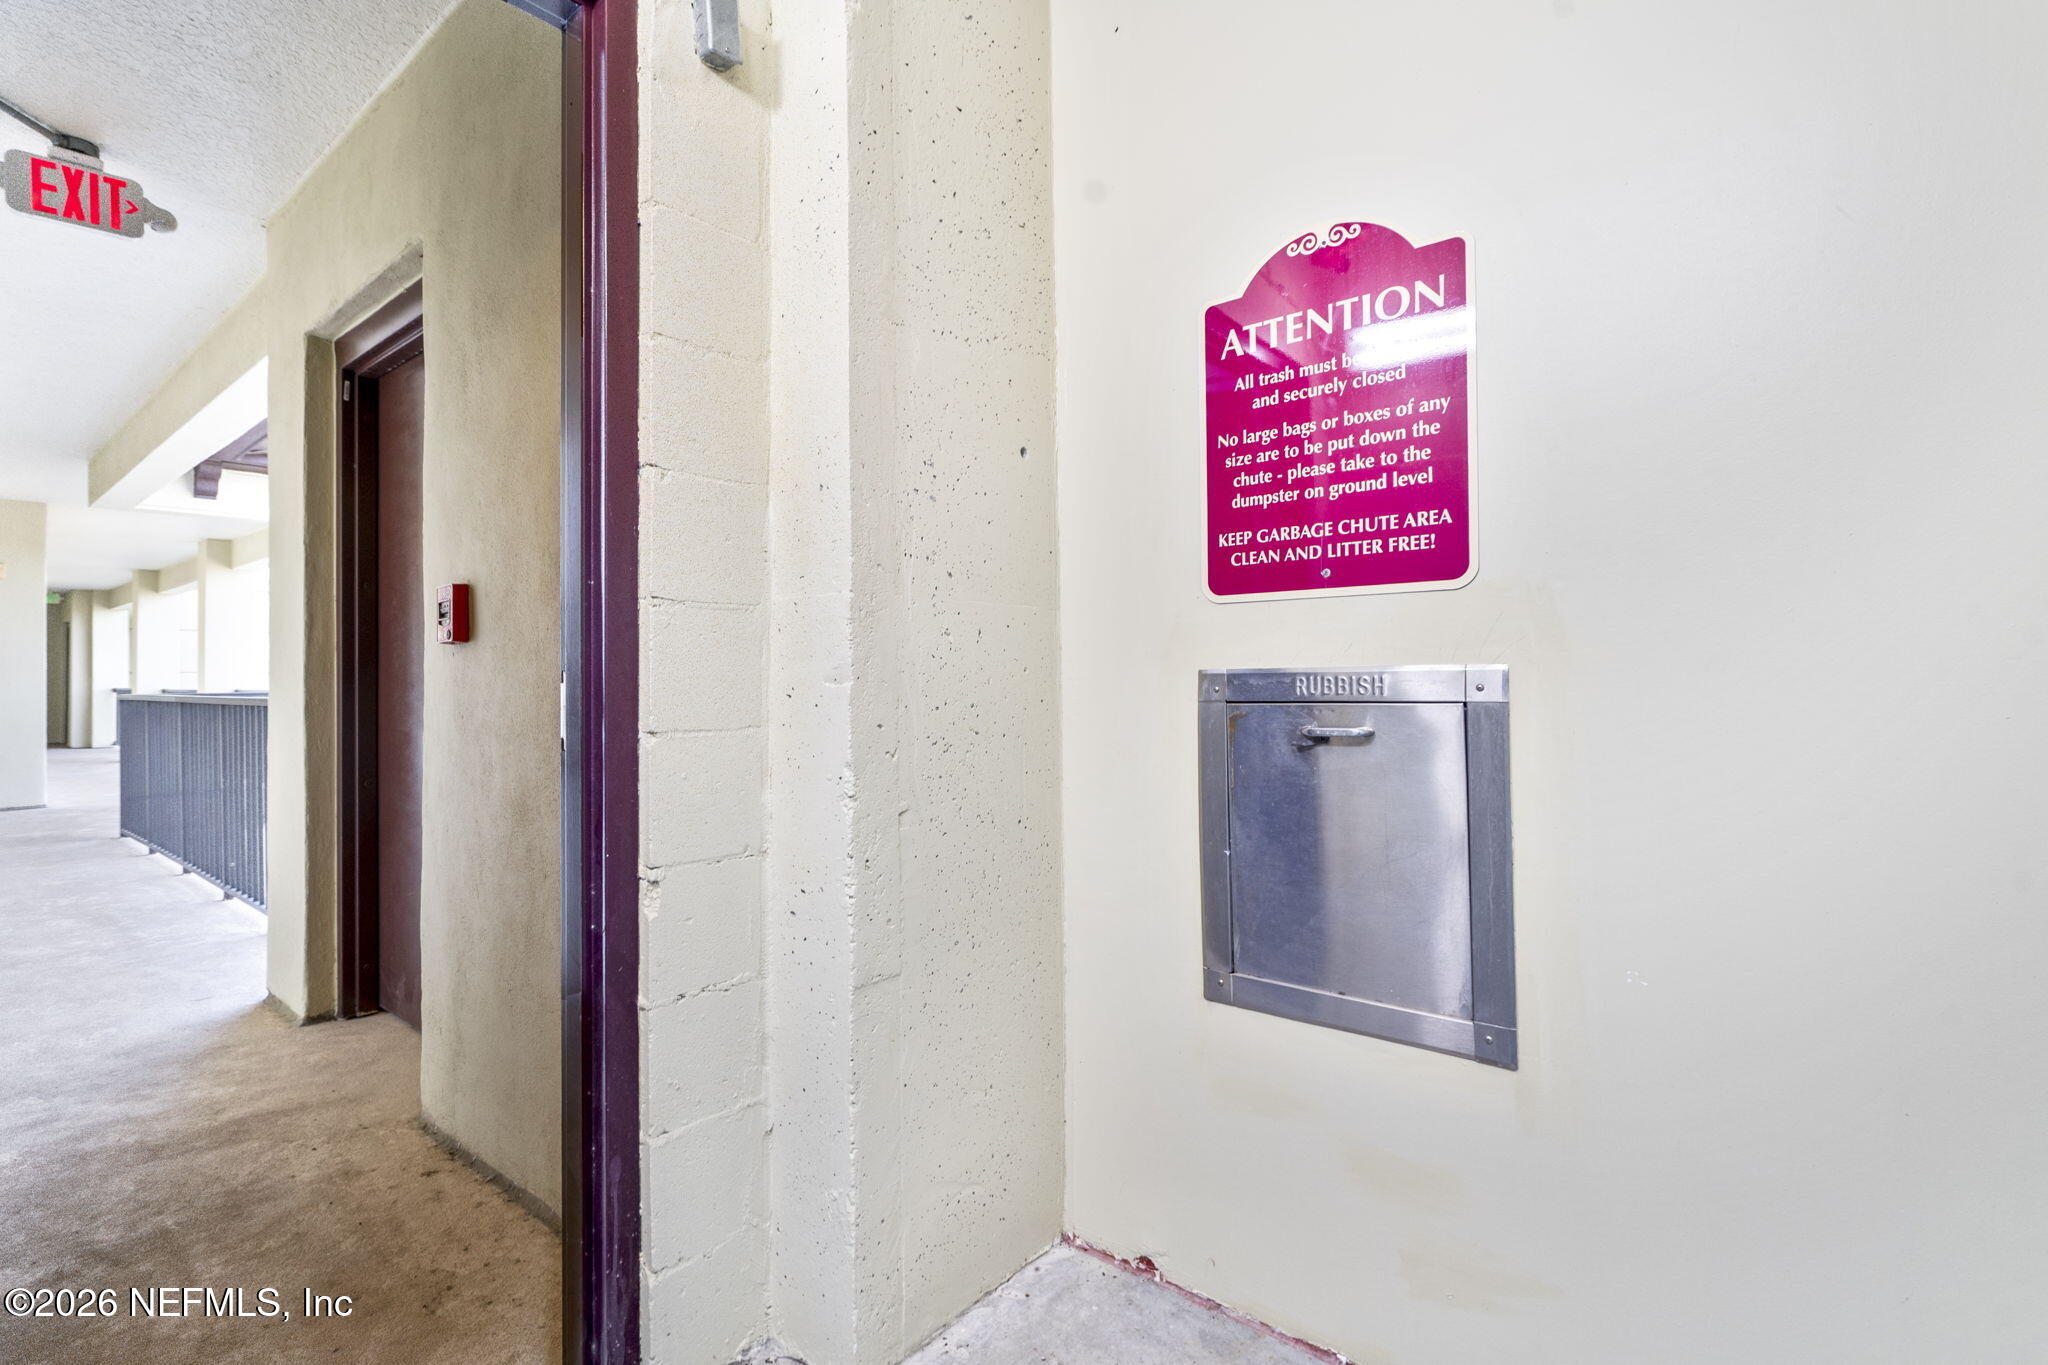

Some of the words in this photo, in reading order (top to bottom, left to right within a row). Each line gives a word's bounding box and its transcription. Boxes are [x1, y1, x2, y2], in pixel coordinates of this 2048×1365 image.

[30, 157, 127, 230] EXIT
[1221, 274, 1445, 360] ATTENTION
[1235, 374, 1254, 391] All
[1259, 366, 1294, 387] trash
[1300, 359, 1338, 378] must
[1252, 390, 1279, 409] and
[1284, 378, 1347, 401] securely
[1352, 364, 1406, 388] closed
[1217, 434, 1239, 448] No
[1242, 427, 1278, 447] large
[1283, 421, 1317, 439] bags
[1321, 416, 1339, 429] or
[1344, 408, 1391, 426] boxes
[1396, 398, 1415, 416] of
[1418, 396, 1451, 414] any
[1225, 453, 1252, 468] size
[1256, 450, 1280, 462] are
[1284, 445, 1299, 457] to
[1304, 439, 1322, 455] be
[1328, 435, 1355, 456] put
[1359, 428, 1406, 447] down
[1412, 420, 1441, 436] the
[1233, 471, 1272, 487] chute
[1287, 461, 1335, 484] please
[1340, 456, 1375, 471] take
[1380, 451, 1397, 465] to
[1403, 446, 1431, 462] the
[1232, 491, 1299, 509] dumpster
[1304, 487, 1324, 499] on
[1329, 474, 1387, 500] ground
[1393, 467, 1433, 487] level
[1218, 531, 1252, 547] KEEP
[1257, 522, 1333, 544] GARBAGE
[1338, 514, 1399, 535] CHUTE
[1403, 509, 1452, 528] AREA
[1230, 549, 1280, 567] CLEAN
[1284, 545, 1321, 562] AND
[1327, 538, 1383, 558] LITTER
[1389, 534, 1436, 552] FREE!
[1296, 674, 1388, 696] RUBBISH
